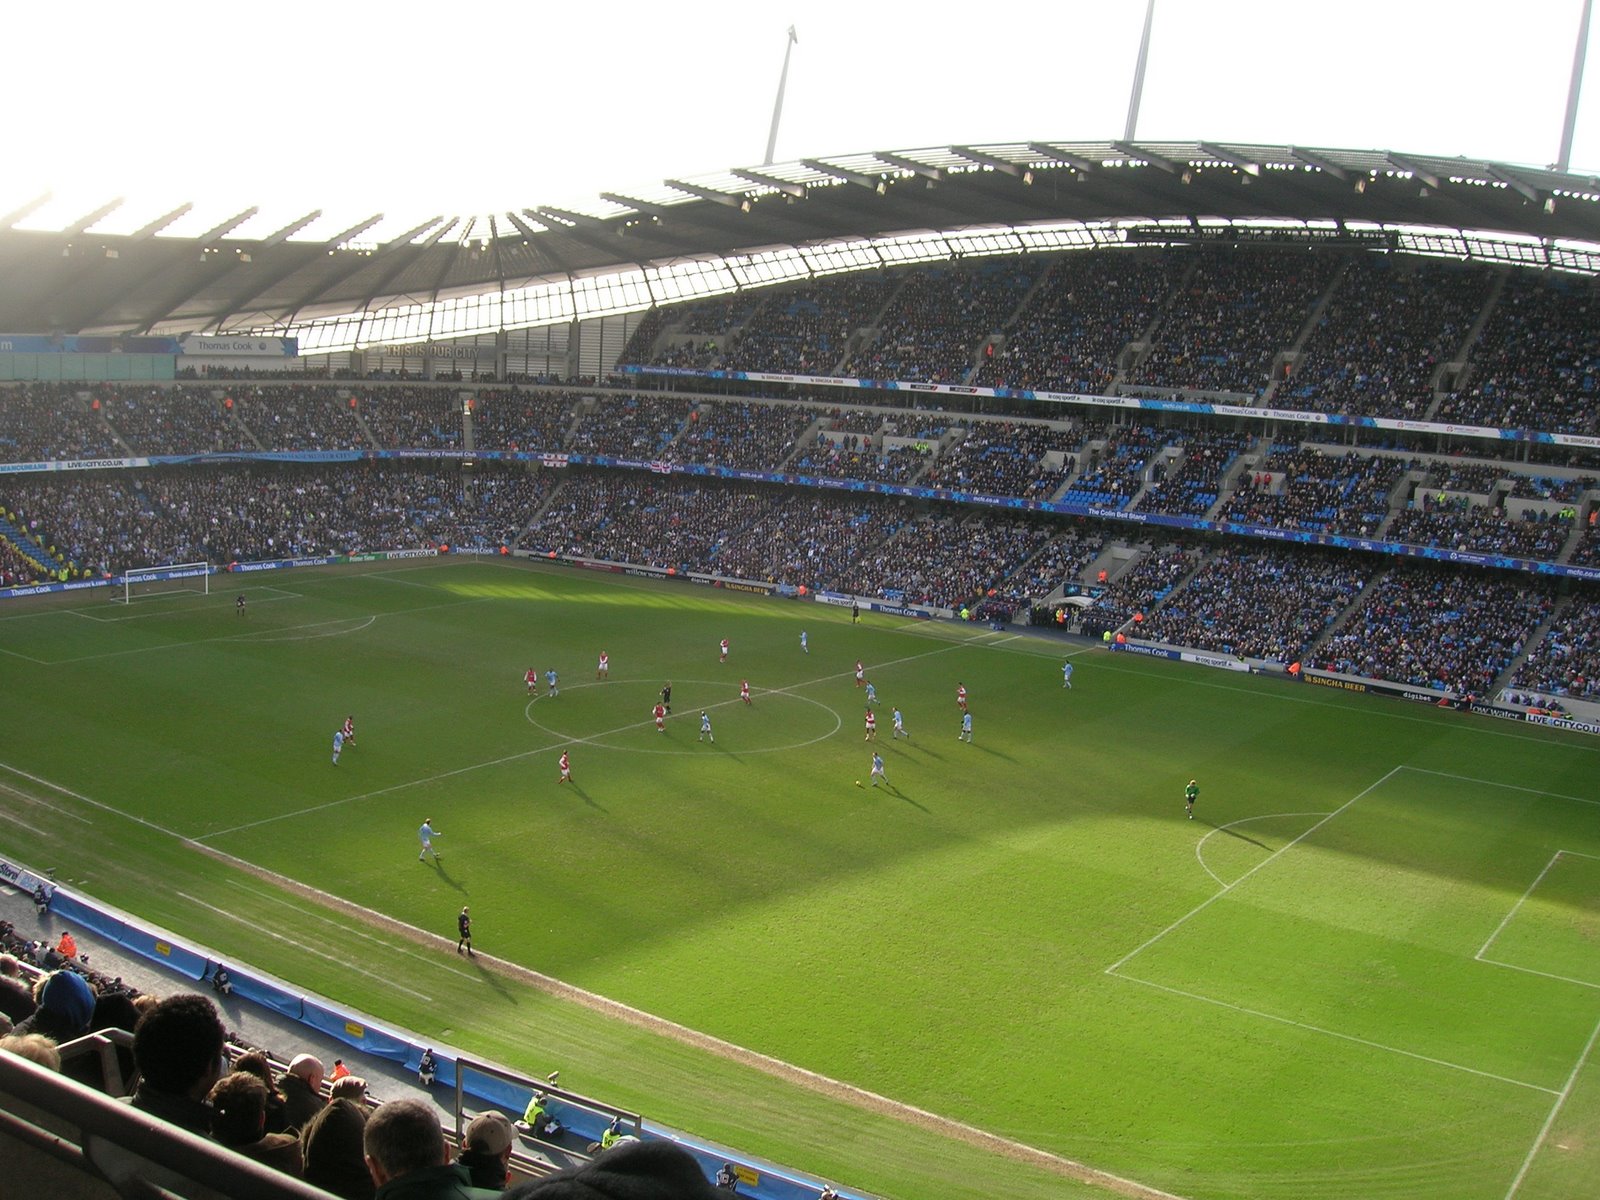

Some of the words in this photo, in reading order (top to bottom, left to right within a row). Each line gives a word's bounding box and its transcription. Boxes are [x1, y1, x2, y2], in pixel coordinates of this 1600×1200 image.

[199, 340, 230, 350] Thomas
[232, 341, 252, 350] Cook
[385, 345, 411, 357] THIS
[412, 346, 426, 357] IS
[430, 346, 452, 358] OUR
[455, 347, 480, 360] CITY
[1254, 528, 1285, 538] mcfc.co.uk
[10, 588, 36, 596] Thomas
[36, 586, 52, 594] Cook
[880, 606, 902, 614] Thomas
[1124, 644, 1151, 654] Thomas
[1152, 648, 1169, 658] Cook
[1201, 658, 1210, 666] coq
[1211, 658, 1228, 668] sportif
[1312, 677, 1343, 688] SINGHA
[1344, 682, 1366, 692] BEER
[1403, 692, 1432, 702] digibet
[1490, 710, 1520, 720] water
